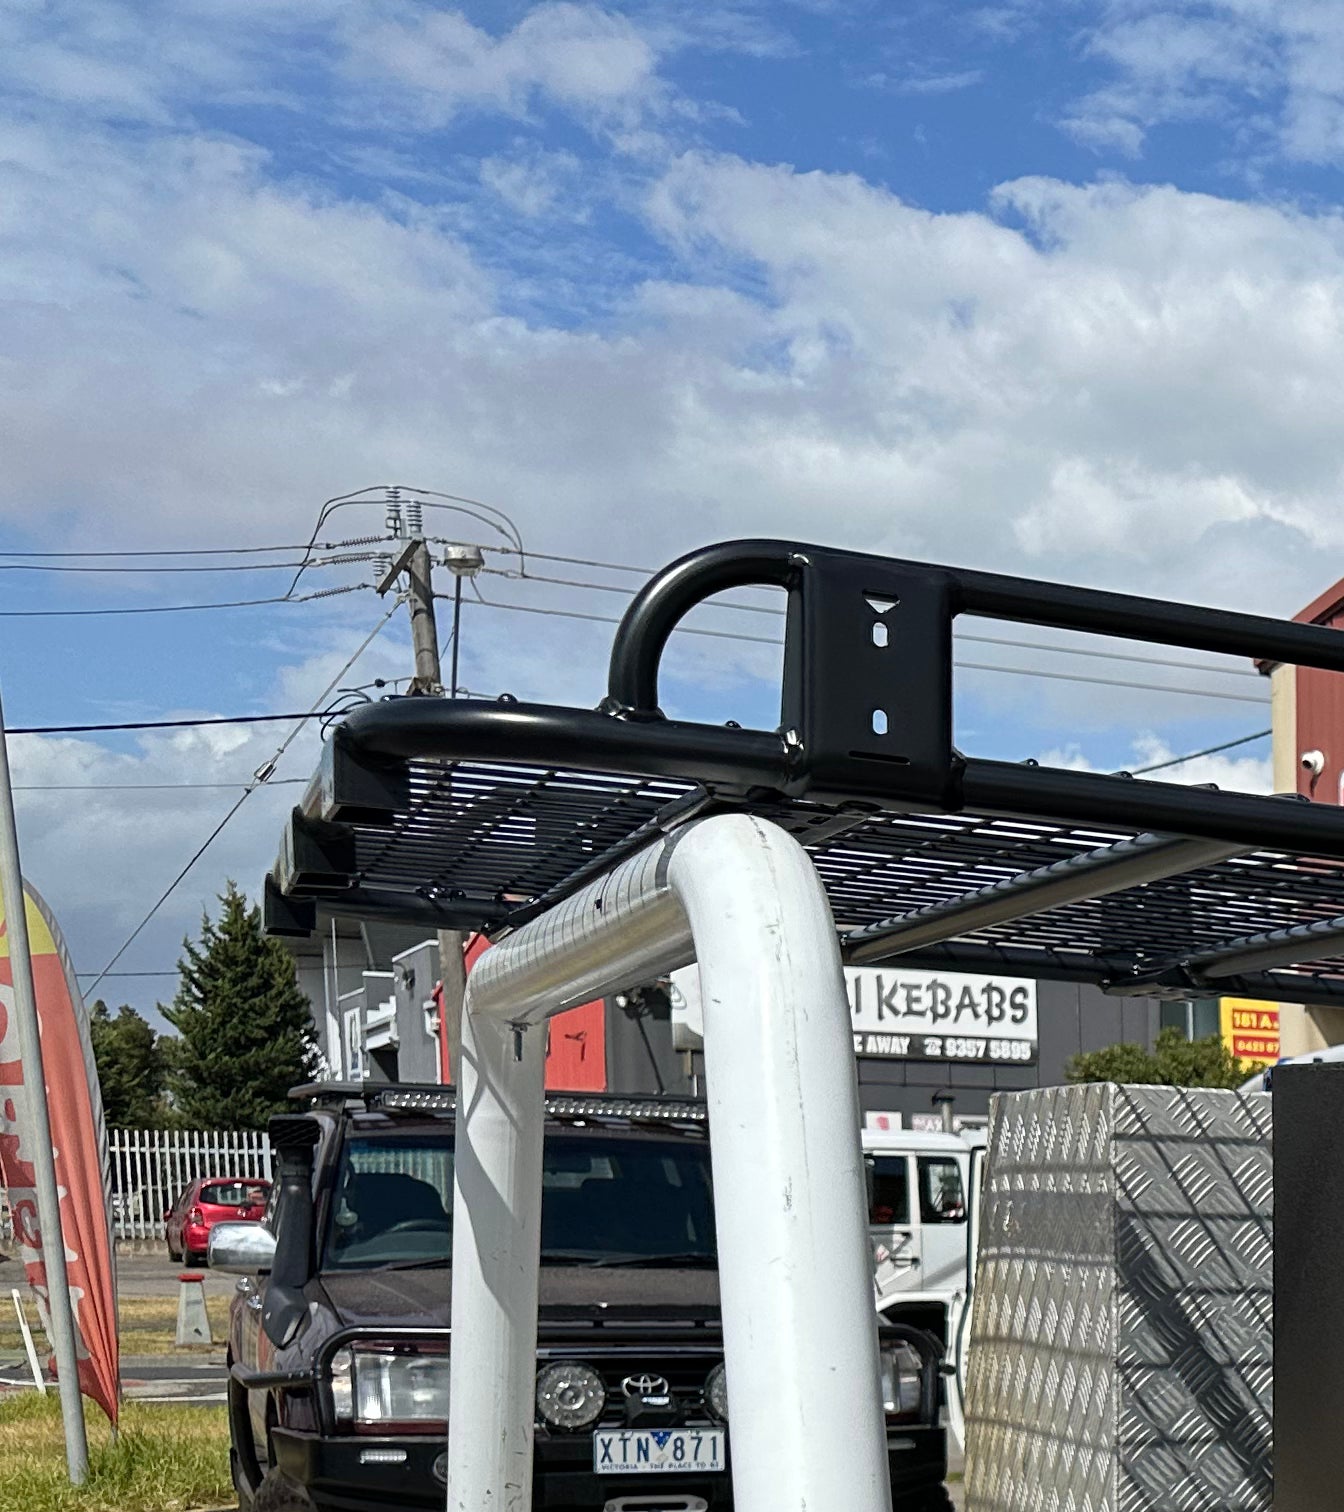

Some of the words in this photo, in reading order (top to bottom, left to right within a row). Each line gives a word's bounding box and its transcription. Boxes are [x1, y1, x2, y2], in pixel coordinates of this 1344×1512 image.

[875, 974, 1030, 1028] KEBABS
[866, 1034, 911, 1055] AWAY
[600, 1436, 650, 1463] XTN
[673, 1435, 718, 1461] 871
